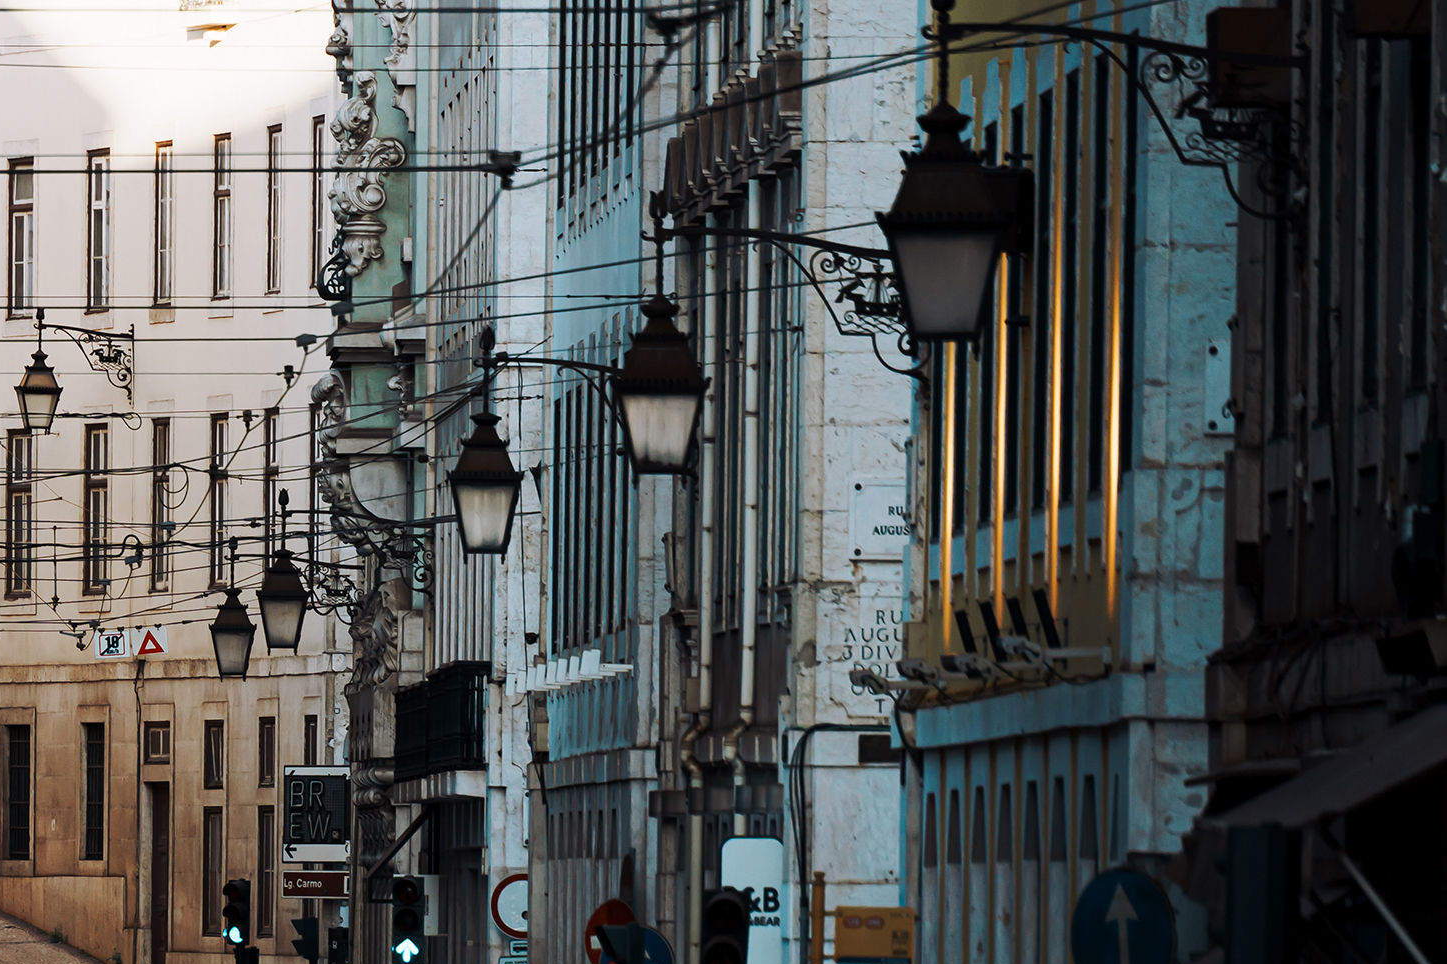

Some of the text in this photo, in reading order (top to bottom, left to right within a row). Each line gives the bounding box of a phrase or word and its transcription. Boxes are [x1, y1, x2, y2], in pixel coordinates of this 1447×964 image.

[888, 505, 904, 516] RU
[872, 525, 911, 536] AUGUS
[876, 610, 903, 625] RU
[296, 878, 323, 888] Carmo
